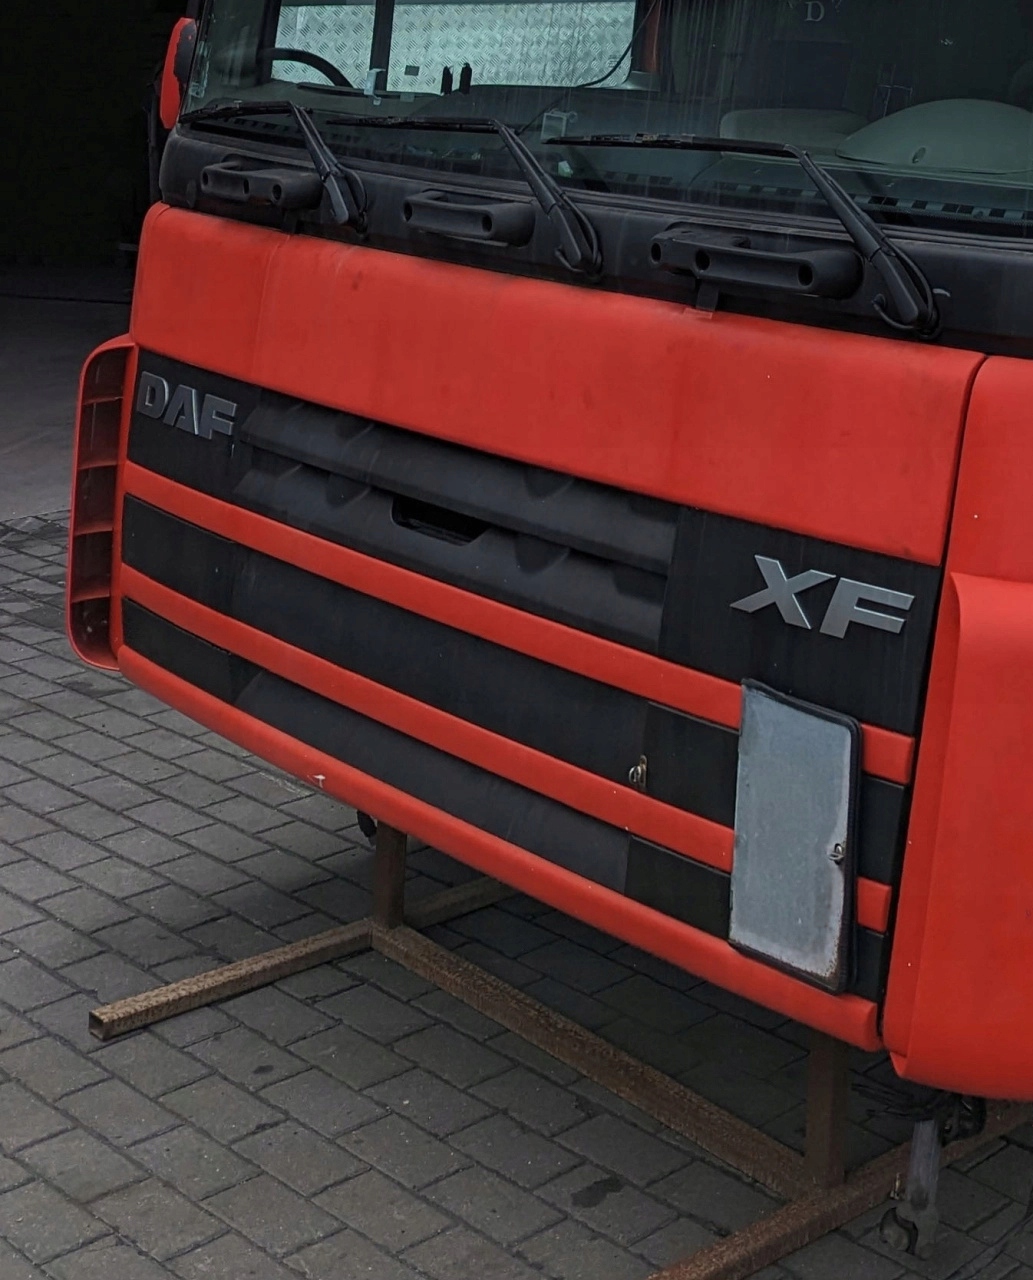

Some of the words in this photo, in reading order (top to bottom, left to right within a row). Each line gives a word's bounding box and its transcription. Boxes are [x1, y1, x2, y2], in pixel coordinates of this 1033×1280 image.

[804, 1, 825, 22] D
[137, 370, 237, 440] DAF
[729, 554, 915, 639] XF
